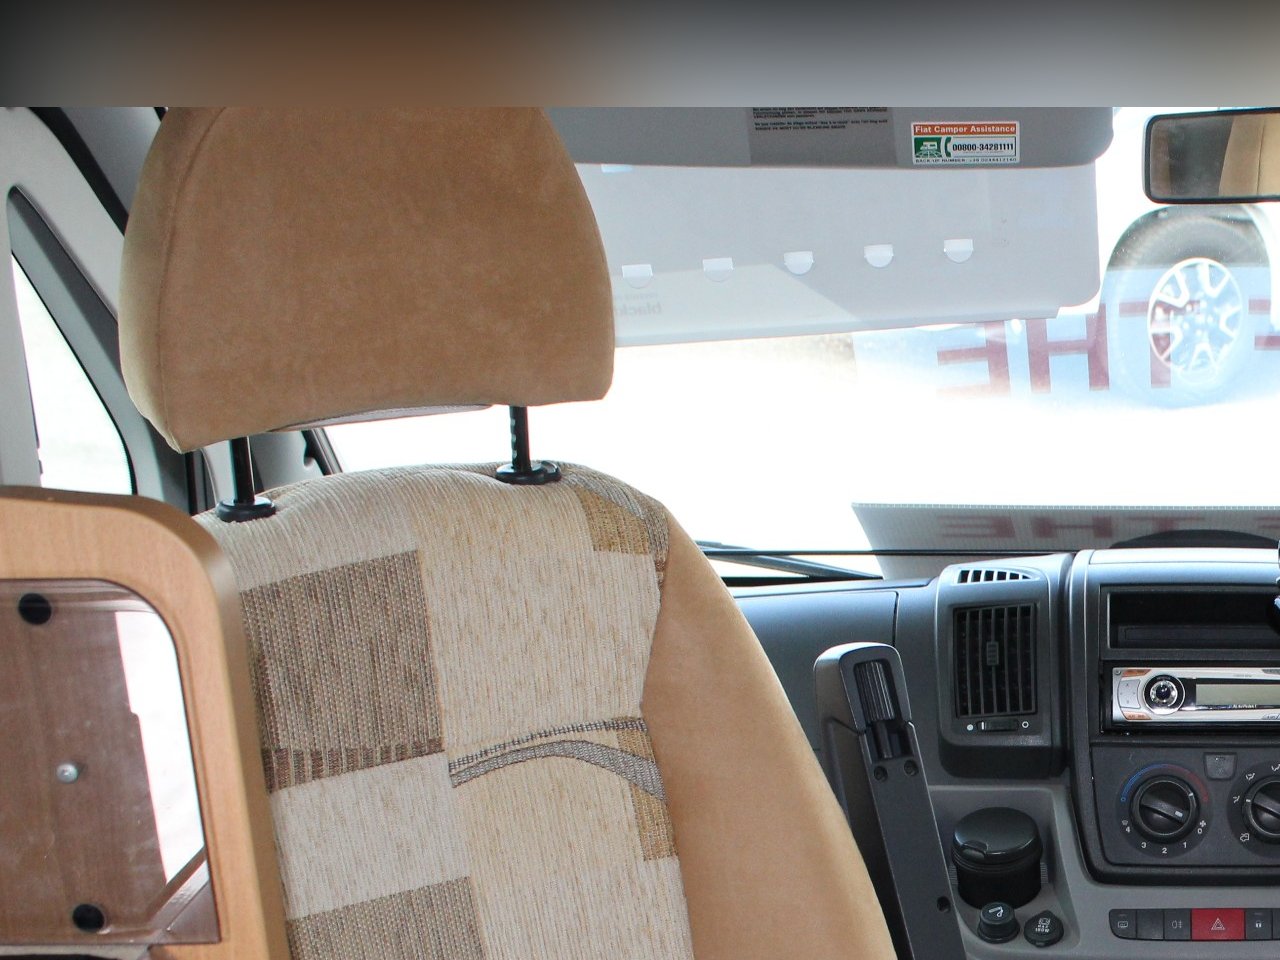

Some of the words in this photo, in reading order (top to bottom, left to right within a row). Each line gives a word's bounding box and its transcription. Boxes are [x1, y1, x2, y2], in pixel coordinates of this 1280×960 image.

[915, 125, 931, 133] Fiat
[934, 125, 967, 134] Camper
[970, 125, 1015, 133] Assistance
[952, 143, 1014, 152] 00800-34281111
